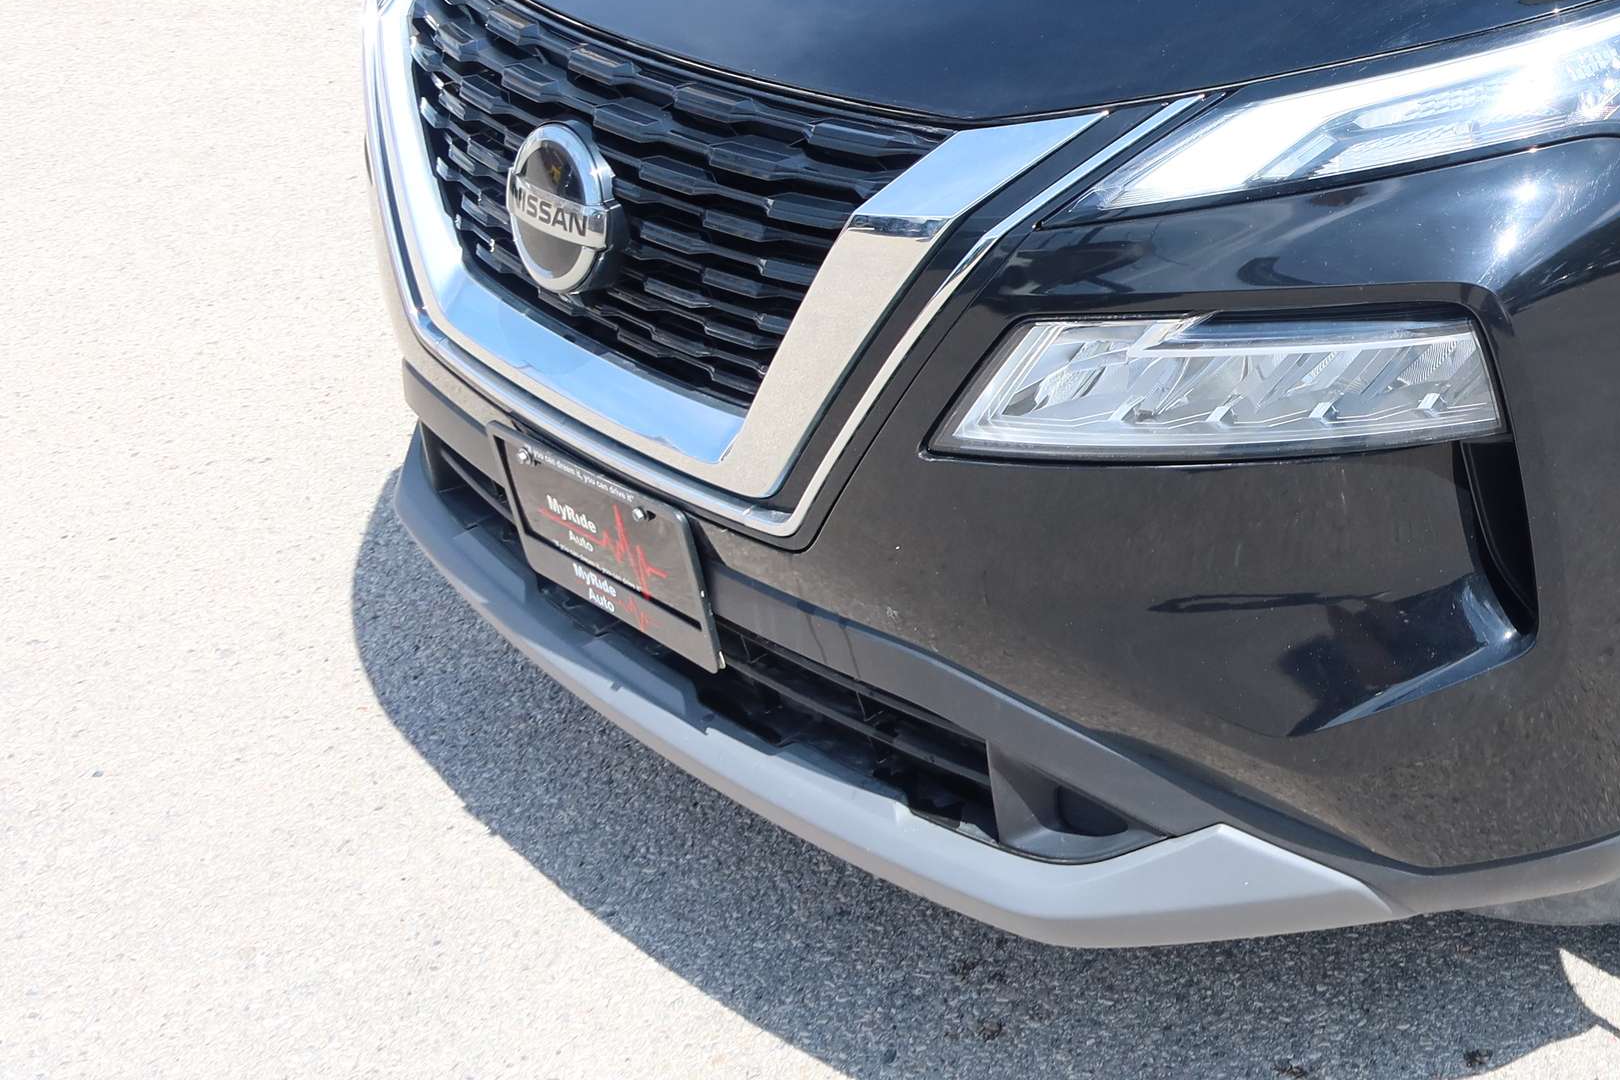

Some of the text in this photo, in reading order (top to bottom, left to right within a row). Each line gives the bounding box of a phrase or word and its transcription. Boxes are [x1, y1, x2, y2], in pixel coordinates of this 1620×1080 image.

[509, 183, 587, 237] NISSAN
[546, 494, 597, 534] MyRide
[568, 529, 594, 552] Auto
[572, 562, 617, 597] MyRide
[588, 587, 615, 612] Auto
